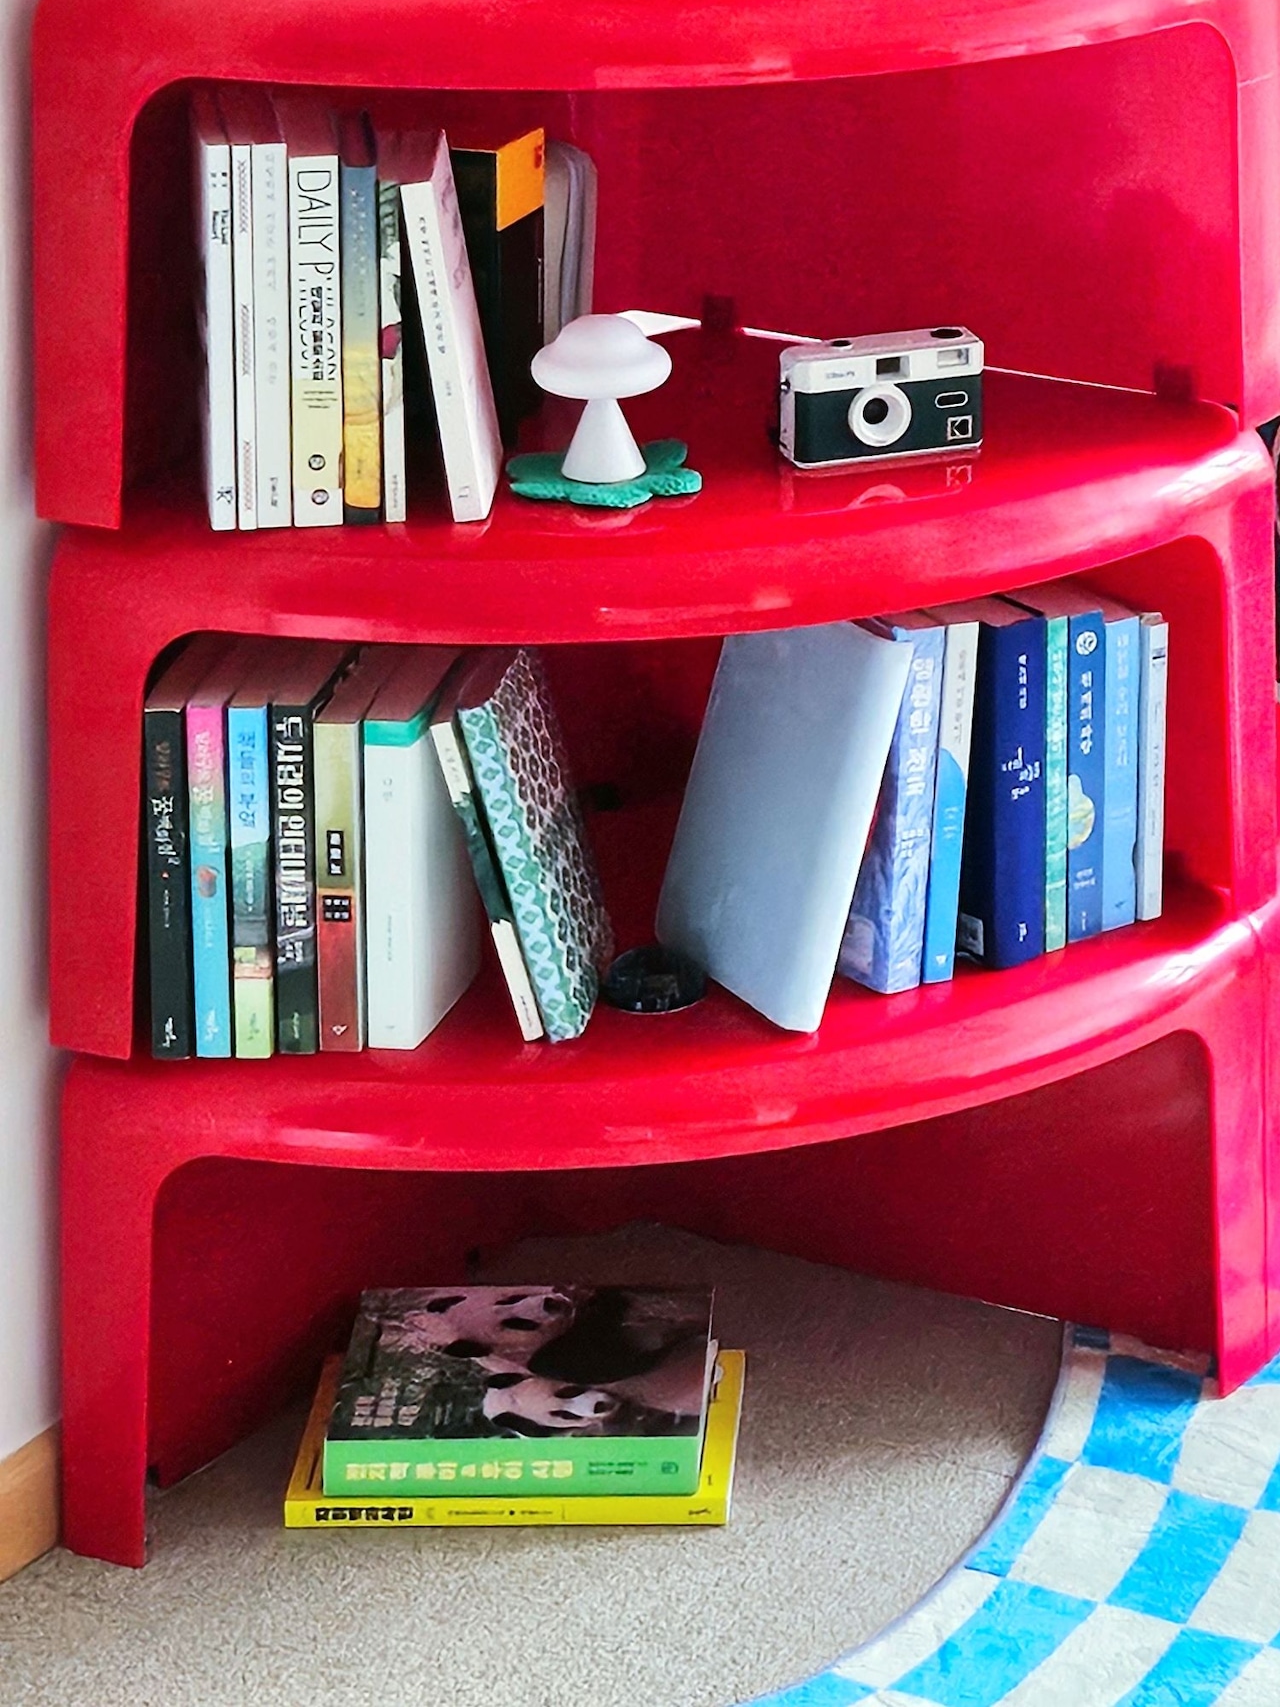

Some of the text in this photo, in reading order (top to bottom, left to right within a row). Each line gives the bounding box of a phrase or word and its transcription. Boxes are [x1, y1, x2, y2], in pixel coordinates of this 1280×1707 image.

[297, 170, 334, 252] DAILY
[275, 716, 304, 739] 두
[275, 742, 305, 811] 사람의
[277, 814, 308, 929] 인터내셔널
